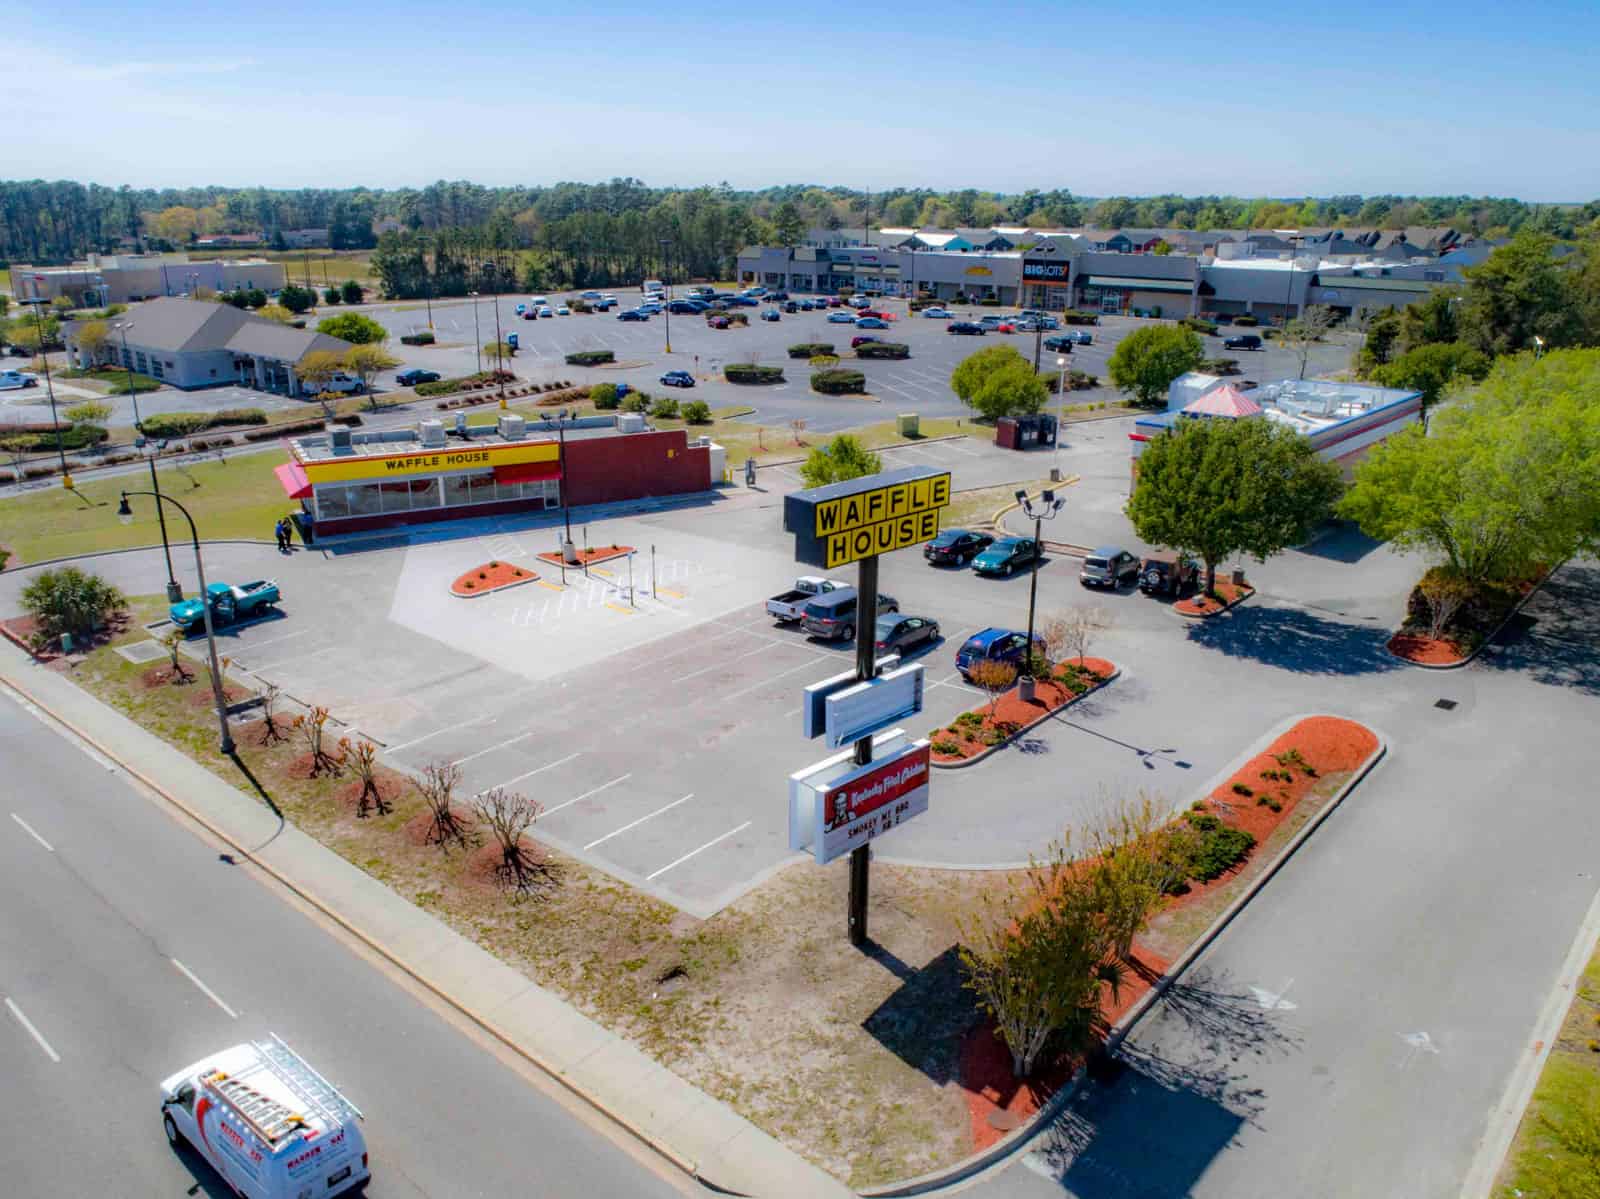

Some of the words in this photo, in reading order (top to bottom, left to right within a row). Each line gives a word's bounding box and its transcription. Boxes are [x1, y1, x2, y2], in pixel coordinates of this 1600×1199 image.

[1024, 264, 1043, 275] BIG
[385, 456, 440, 470] WAFFLE
[447, 452, 489, 464] HOUSE
[820, 480, 946, 531] WAFFLE
[833, 513, 935, 562] HOUSE
[847, 816, 878, 839] SMOKEY
